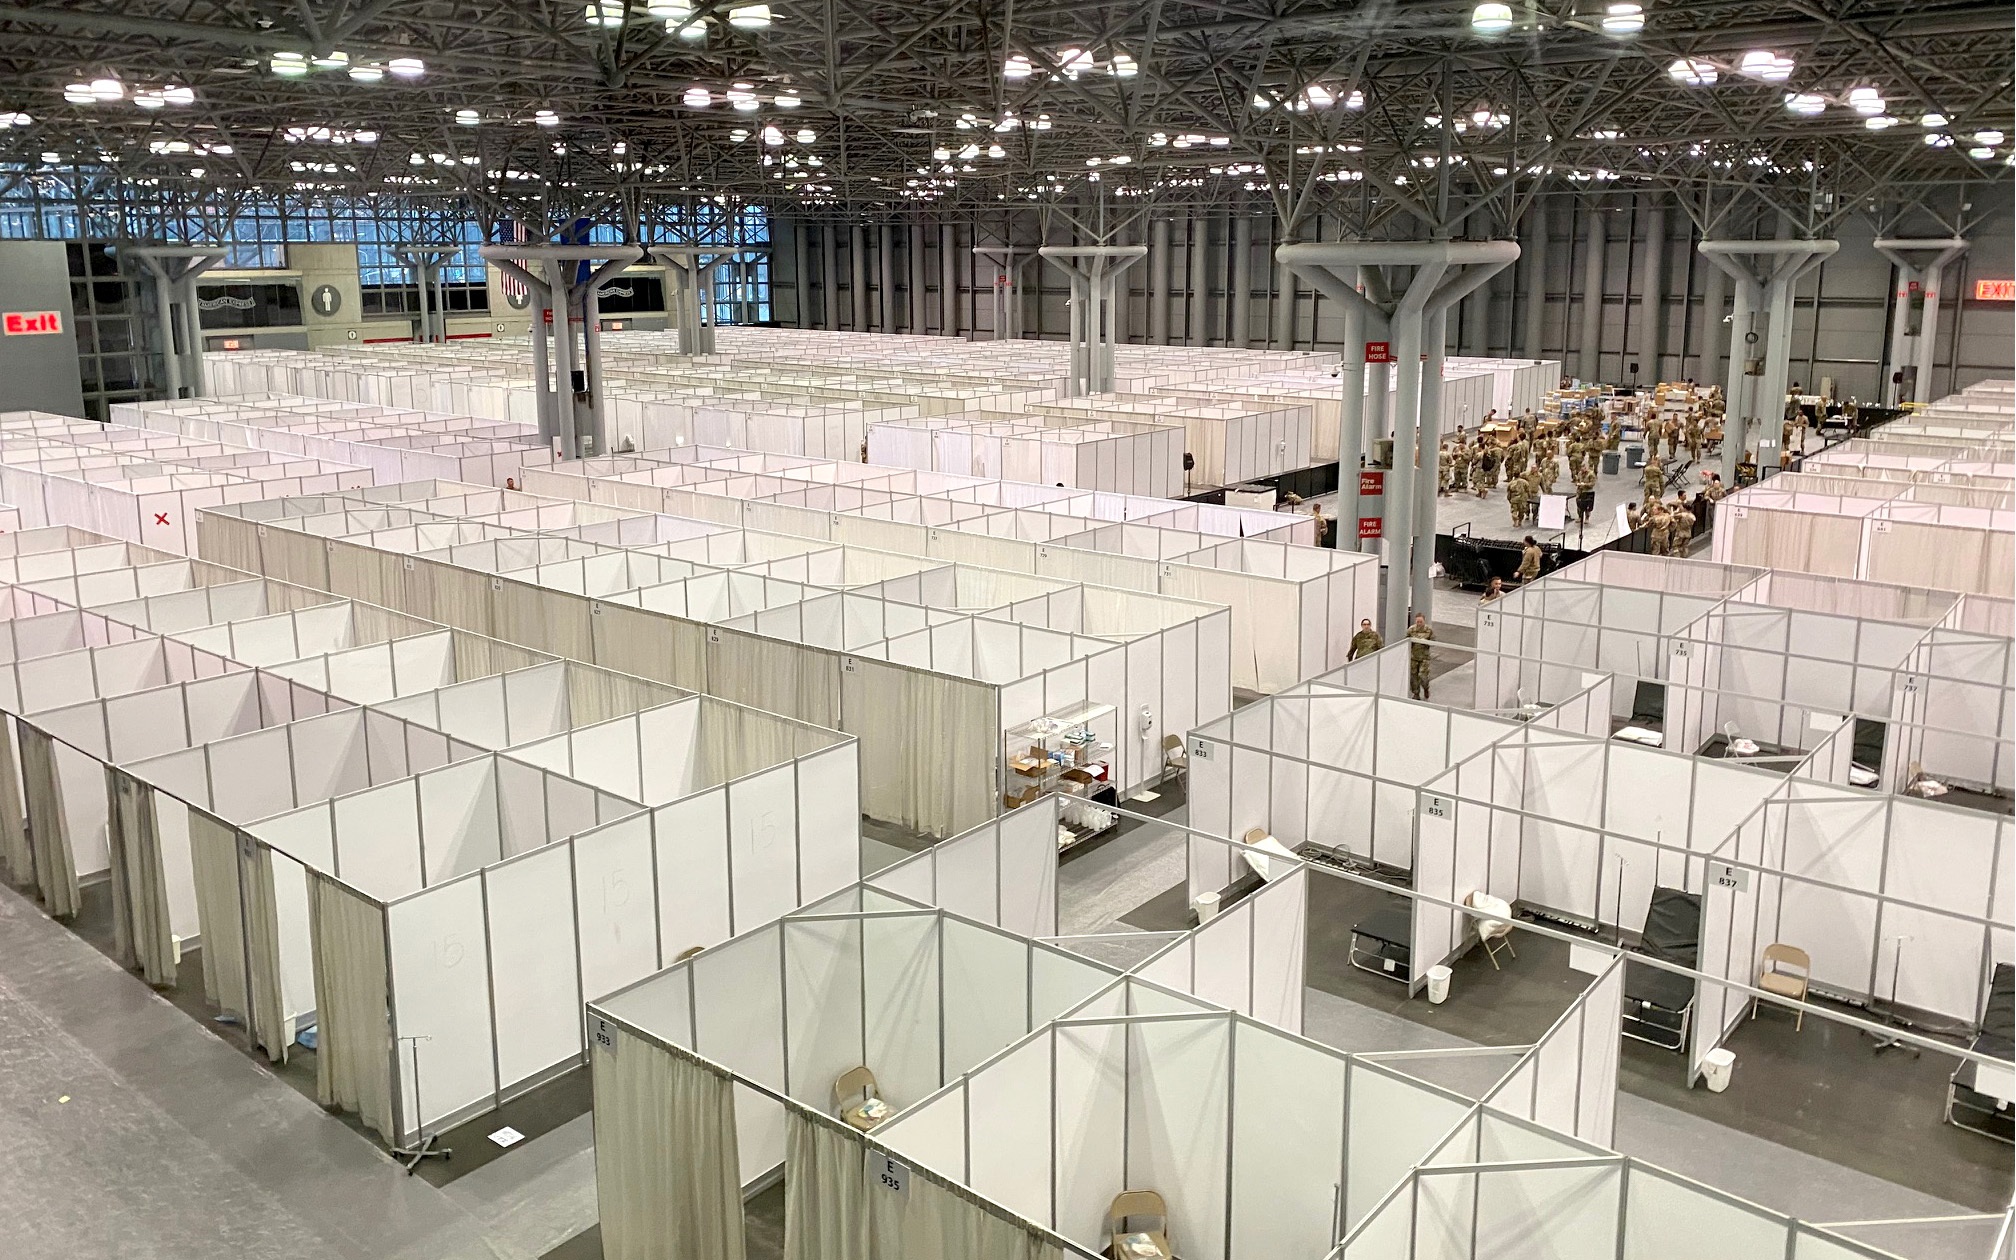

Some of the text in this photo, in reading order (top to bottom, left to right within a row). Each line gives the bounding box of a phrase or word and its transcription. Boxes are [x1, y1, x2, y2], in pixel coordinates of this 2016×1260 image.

[1675, 649, 1687, 657] 735
[1904, 684, 1918, 692] 737
[1195, 749, 1207, 758] 833
[1434, 798, 1439, 806] E
[1428, 807, 1443, 817] 835
[1725, 867, 1733, 876] E
[1718, 877, 1737, 888] 837
[600, 1020, 606, 1032] E
[596, 1032, 611, 1046] 933
[887, 1161, 894, 1173] E
[881, 1174, 900, 1191] 935
